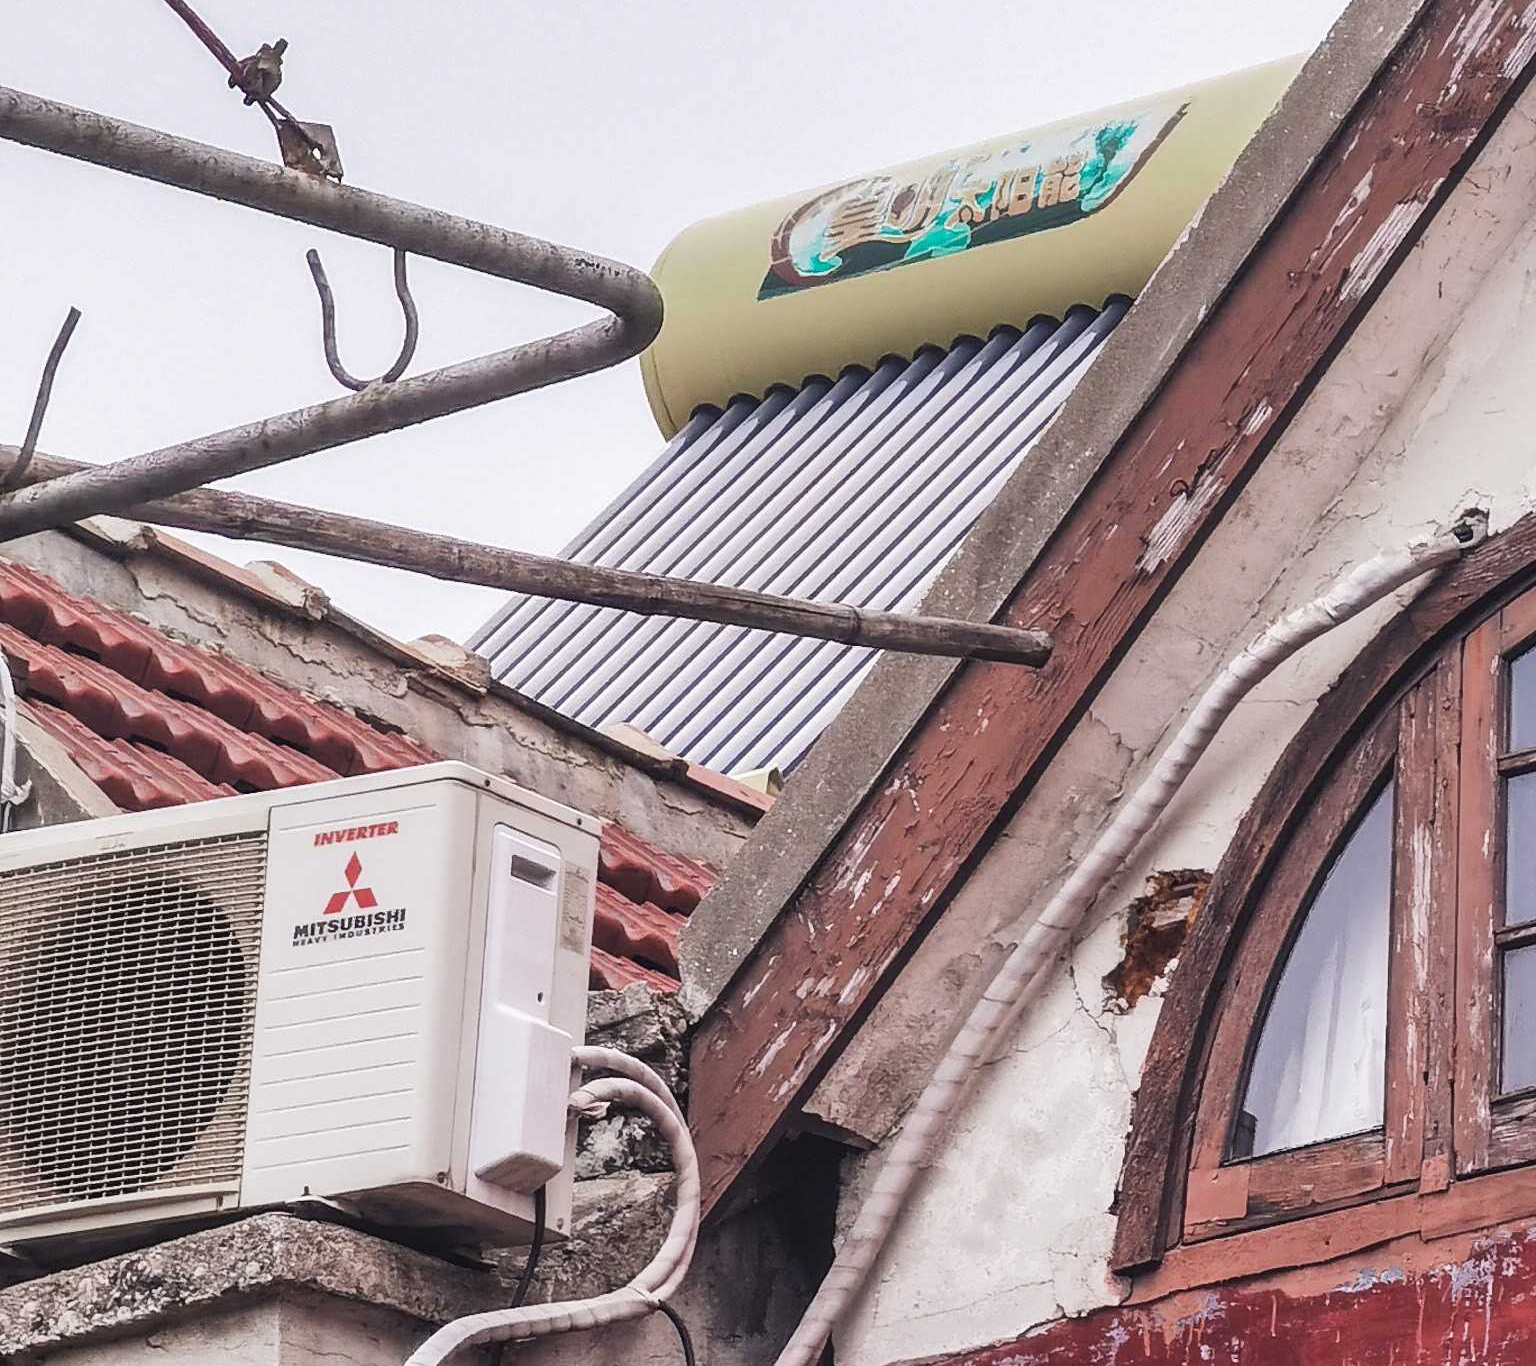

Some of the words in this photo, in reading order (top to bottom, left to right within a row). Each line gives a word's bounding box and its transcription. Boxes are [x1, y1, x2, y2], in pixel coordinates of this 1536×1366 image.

[313, 821, 399, 846] INVERTER
[293, 908, 406, 939] MITSUBISHI
[292, 936, 328, 947] HEAVY
